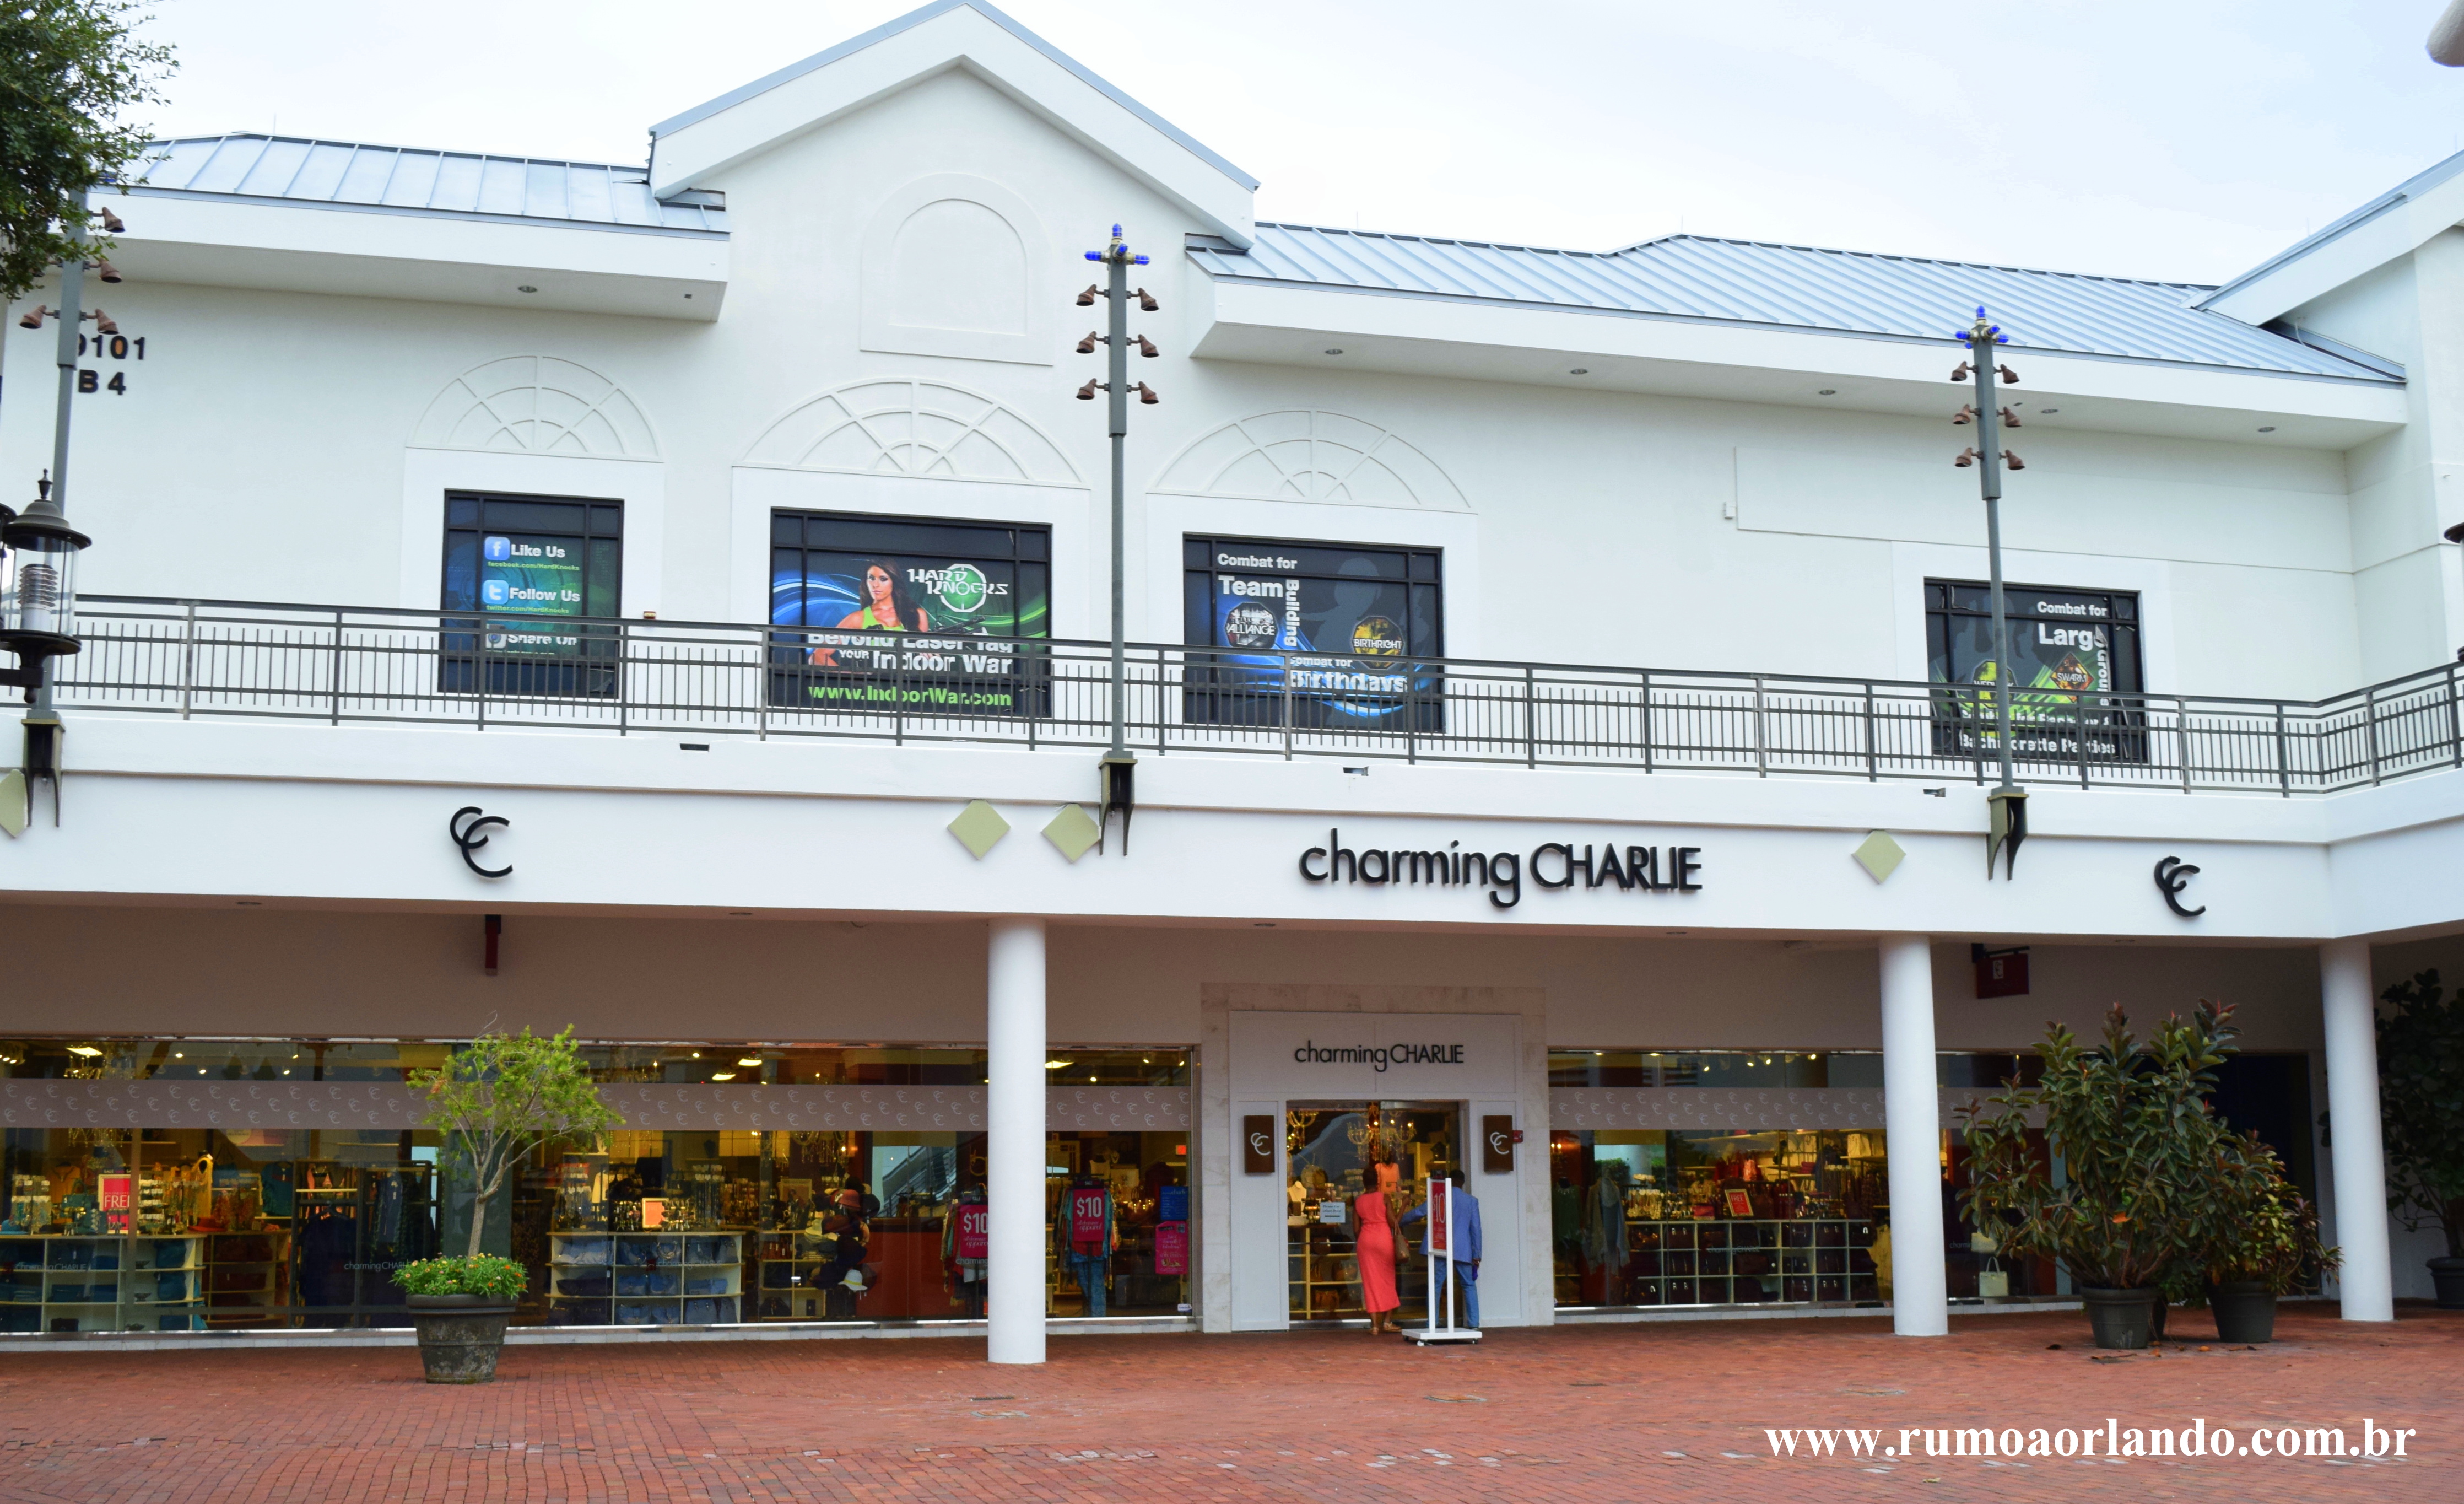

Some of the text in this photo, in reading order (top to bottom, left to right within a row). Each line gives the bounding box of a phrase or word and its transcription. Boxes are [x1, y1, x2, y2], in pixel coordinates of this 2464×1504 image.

[78, 369, 126, 395] B 4
[511, 543, 565, 558] Like Us
[1217, 553, 1298, 569] Combat for
[906, 568, 968, 583] HARD
[509, 587, 580, 602] Follow Us
[925, 580, 1009, 595] KNOCKS
[1218, 575, 1283, 598] Team
[1283, 579, 1300, 647] Building
[2037, 601, 2108, 617] Combat for
[1227, 623, 1277, 636] ALLIANCE
[1353, 638, 1403, 650] BIRTHRIGHT
[839, 649, 1013, 674] YOUR Indoor War
[2057, 672, 2088, 683] SWARM
[2096, 649, 2110, 707] Grous
[2061, 738, 2116, 754] Paties
[1299, 828, 1703, 908] charming CHARLIE
[1294, 1040, 1465, 1072] charming CHARLIE
[104, 1195, 131, 1208] FRE
[1076, 1196, 1102, 1218] $10
[963, 1212, 988, 1233] $10
